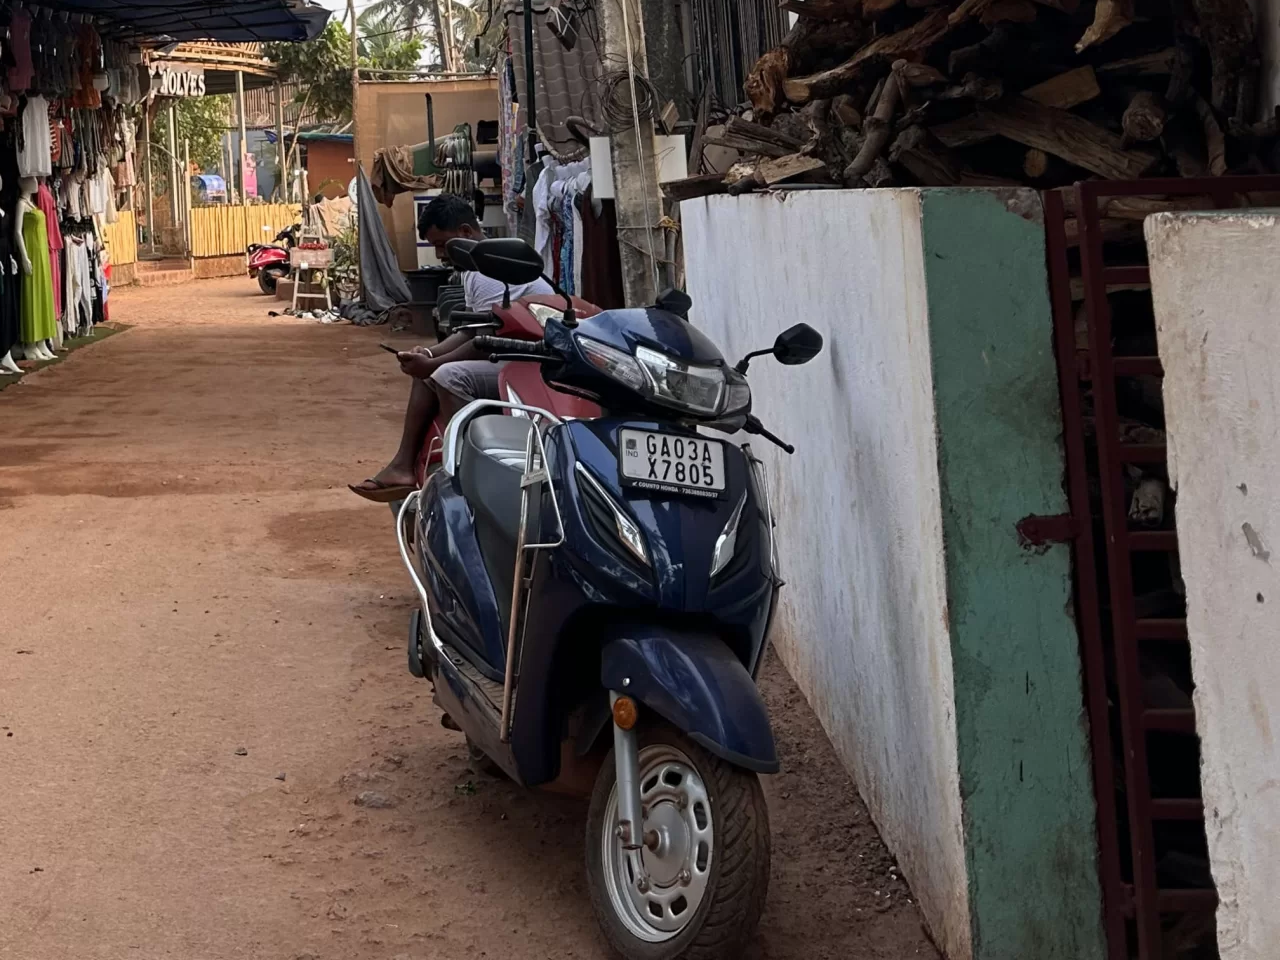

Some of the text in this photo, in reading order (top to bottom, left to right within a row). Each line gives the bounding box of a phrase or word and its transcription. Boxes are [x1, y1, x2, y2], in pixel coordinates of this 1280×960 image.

[625, 450, 639, 458] IND
[646, 434, 712, 463] GA03A
[648, 457, 714, 486] X7805
[660, 485, 679, 493] HONDA
